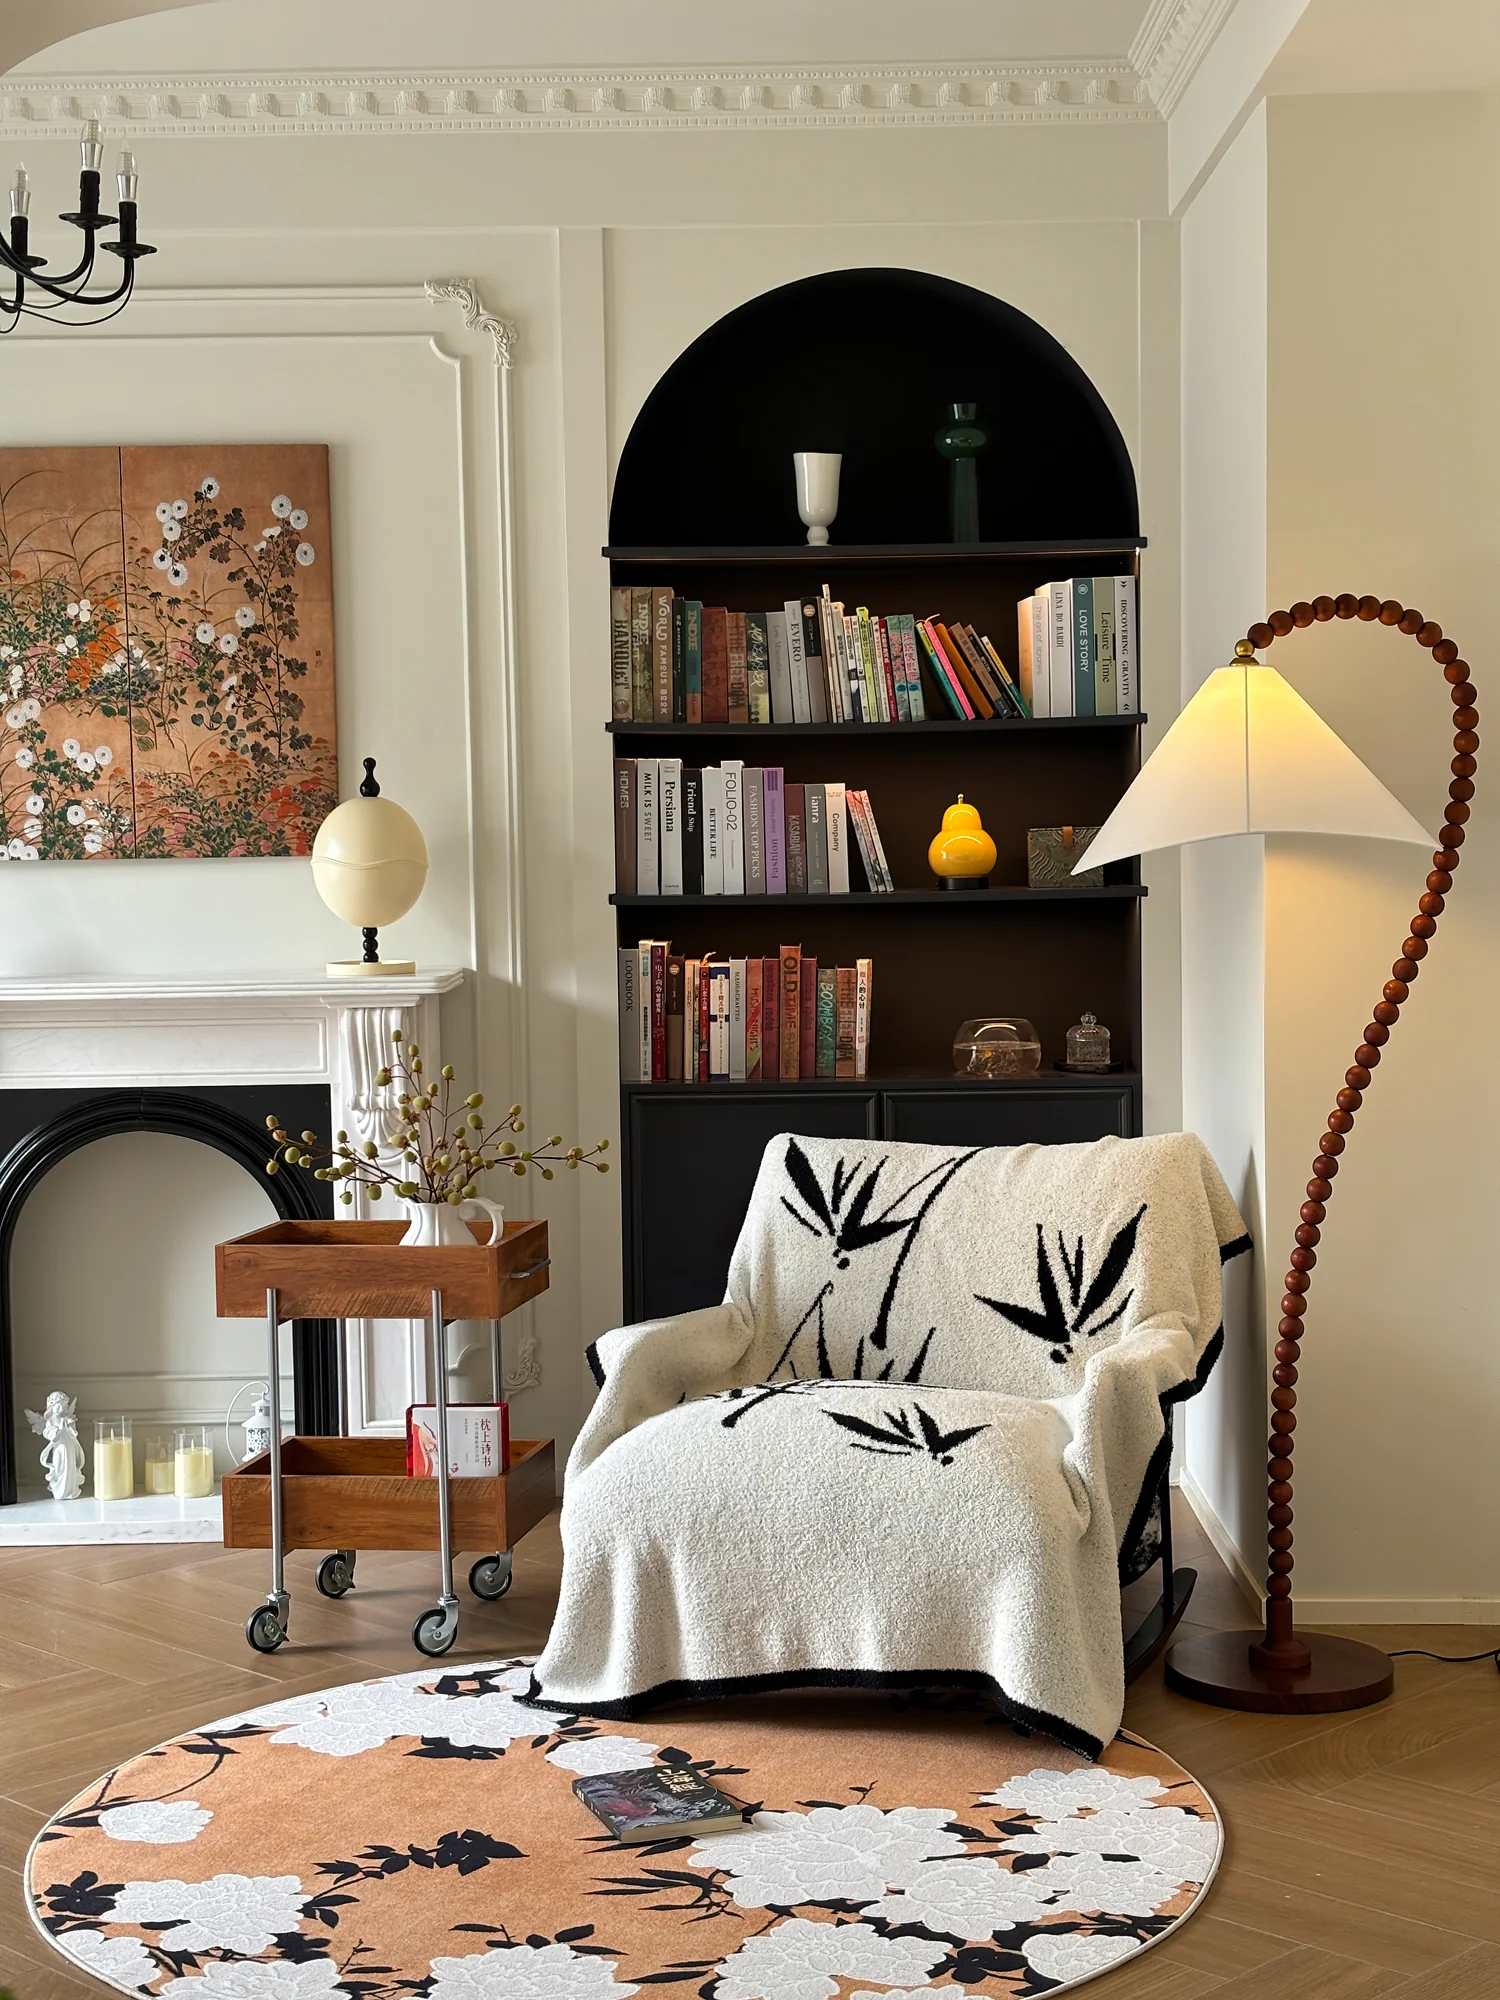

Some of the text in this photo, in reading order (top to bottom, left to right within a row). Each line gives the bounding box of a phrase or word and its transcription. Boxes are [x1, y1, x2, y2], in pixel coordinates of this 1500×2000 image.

[638, 603, 649, 645] INDIE
[656, 595, 670, 640] WORLD
[688, 610, 697, 650] INDIE
[1036, 634, 1043, 643] of
[1055, 592, 1064, 648] LINA BO BARDI
[1079, 610, 1088, 672] LOVE STORY
[614, 620, 630, 690] BANQUET
[791, 623, 802, 662] EVERO
[1101, 612, 1112, 683] Leisure Time
[620, 771, 629, 808] HOMES
[644, 772, 652, 842] MILK IS SWEET
[665, 781, 676, 832] Persiana
[687, 782, 696, 832] Friend Ship
[725, 772, 737, 830] FOLIO-02
[811, 796, 821, 823] ianra
[749, 785, 760, 878] FASHION TOP PICKS
[832, 813, 840, 852] Company
[771, 838, 779, 879] Fashion
[625, 960, 633, 1012] LOOKBOOK
[783, 956, 798, 992] OLD
[819, 983, 834, 1041] BOOMBOX
[480, 1418, 491, 1467] 枕上诗书
